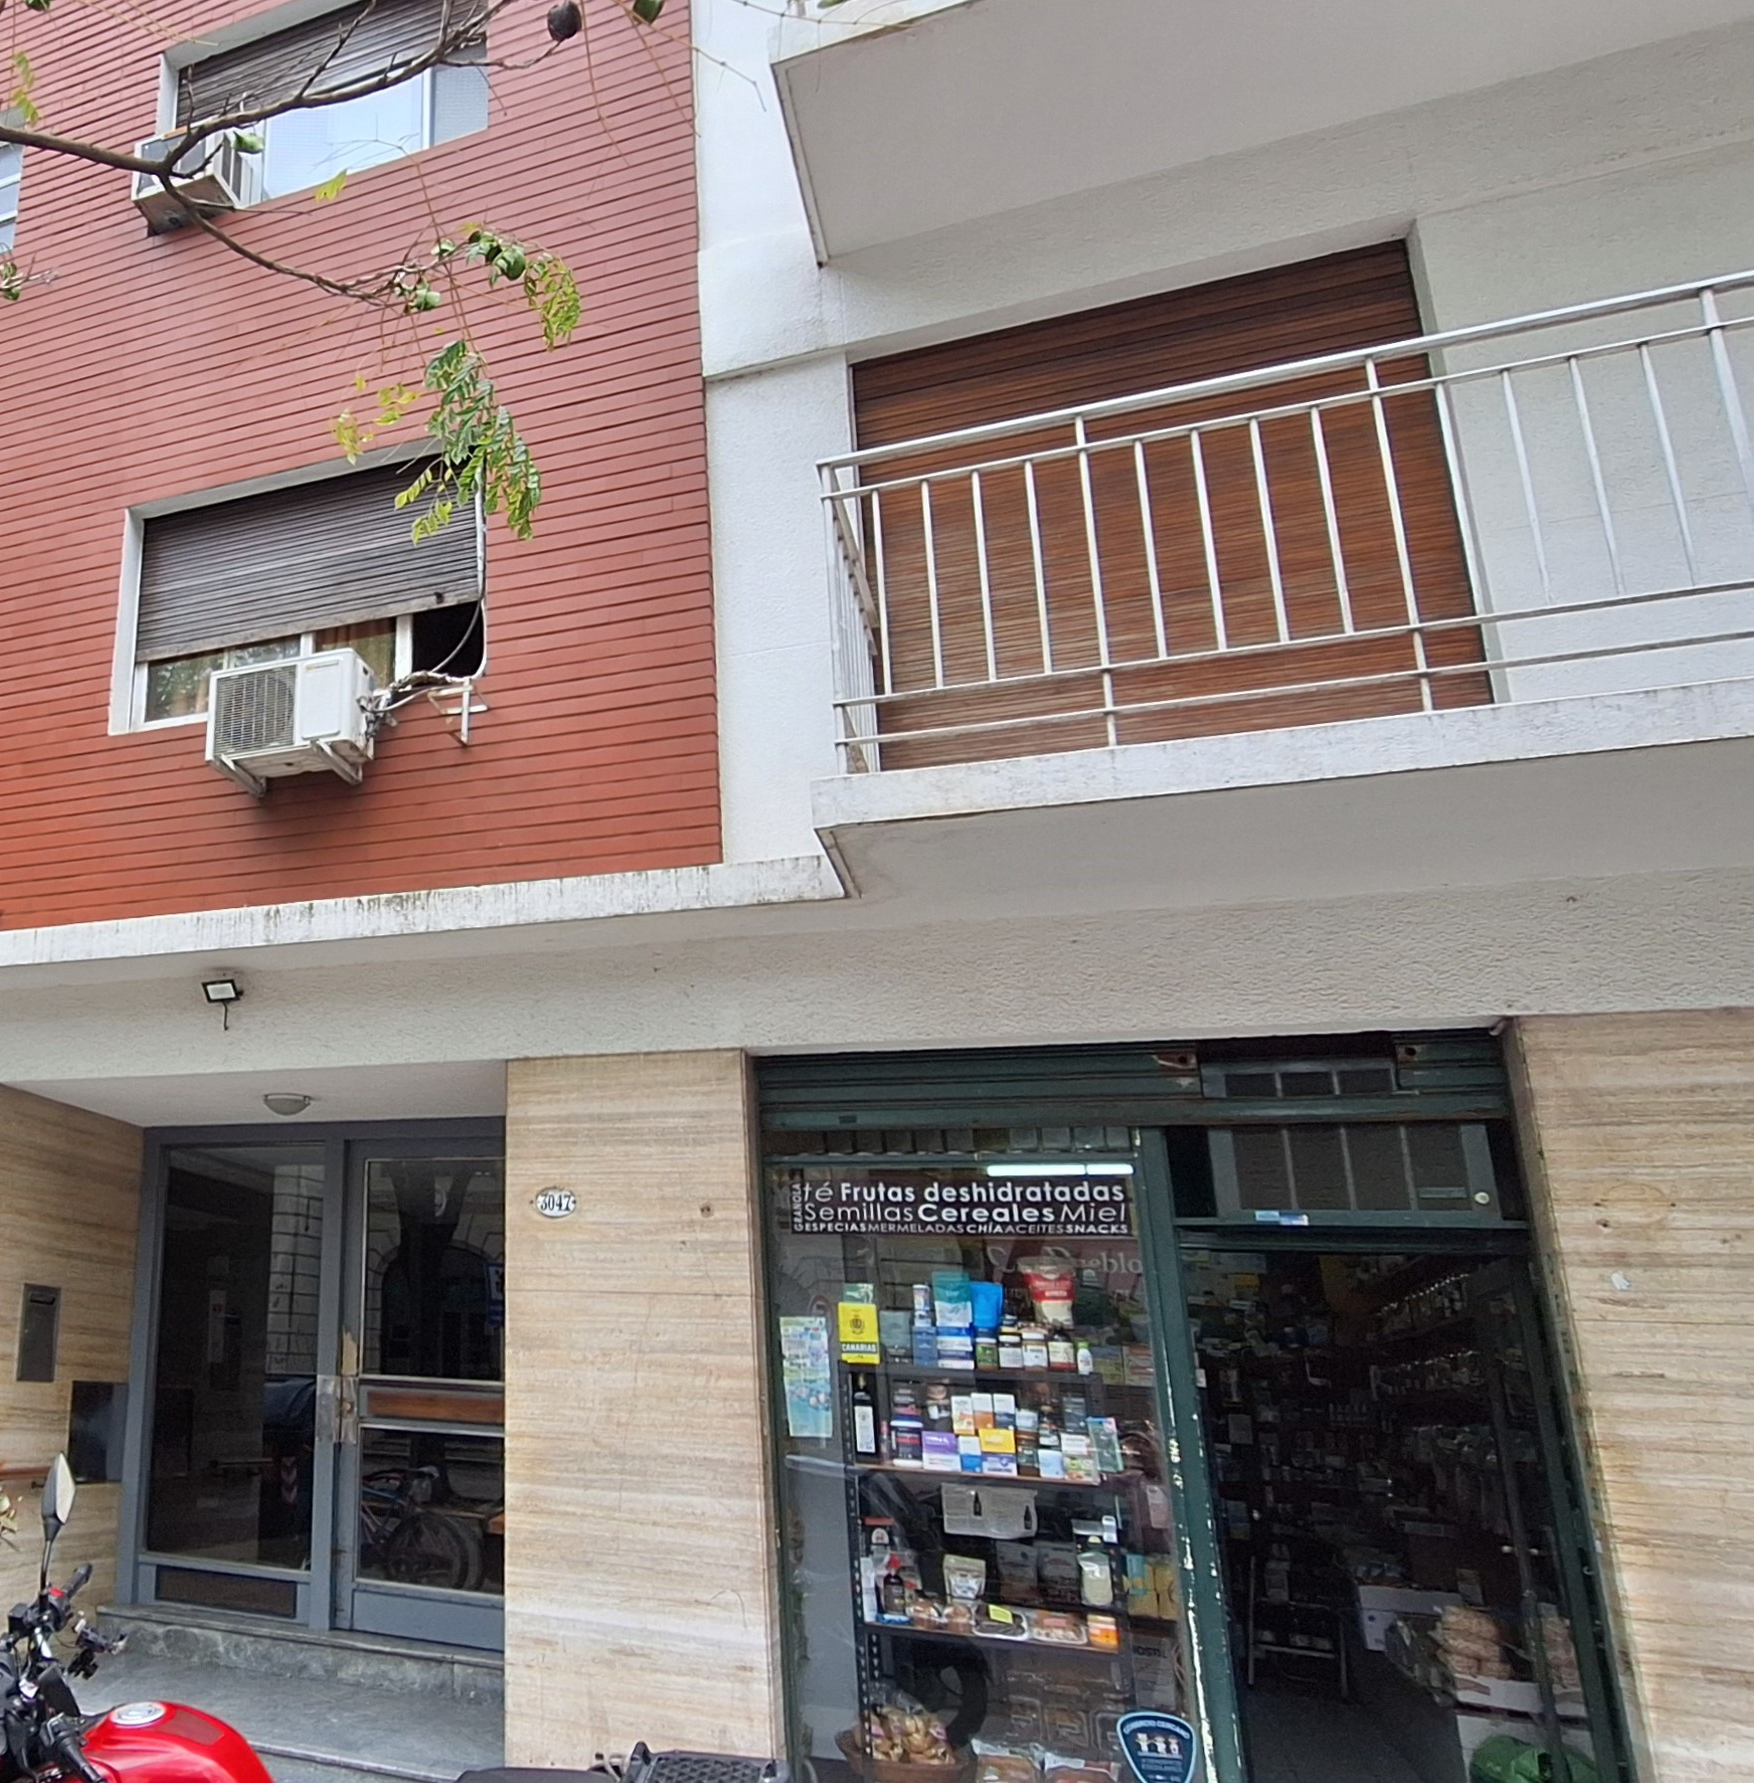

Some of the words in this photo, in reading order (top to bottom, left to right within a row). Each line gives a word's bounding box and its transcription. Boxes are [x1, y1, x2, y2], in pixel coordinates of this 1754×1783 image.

[803, 1181, 833, 1202] té
[841, 1181, 916, 1203] Frutas
[923, 1181, 1125, 1203] deshidratadas
[539, 1193, 572, 1212] 3047
[791, 1183, 804, 1233] GRANOLA
[804, 1202, 914, 1222] Semillas
[917, 1202, 1055, 1223] Cereales
[1060, 1202, 1126, 1222] Miel
[804, 1222, 867, 1233] ESPECIAS
[867, 1223, 965, 1235] MERMELADAS
[966, 1223, 1003, 1234] CHÍA
[1004, 1224, 1066, 1234] ACEITES
[1066, 1224, 1129, 1234] SNACKS
[841, 1342, 877, 1353] CANARIAS
